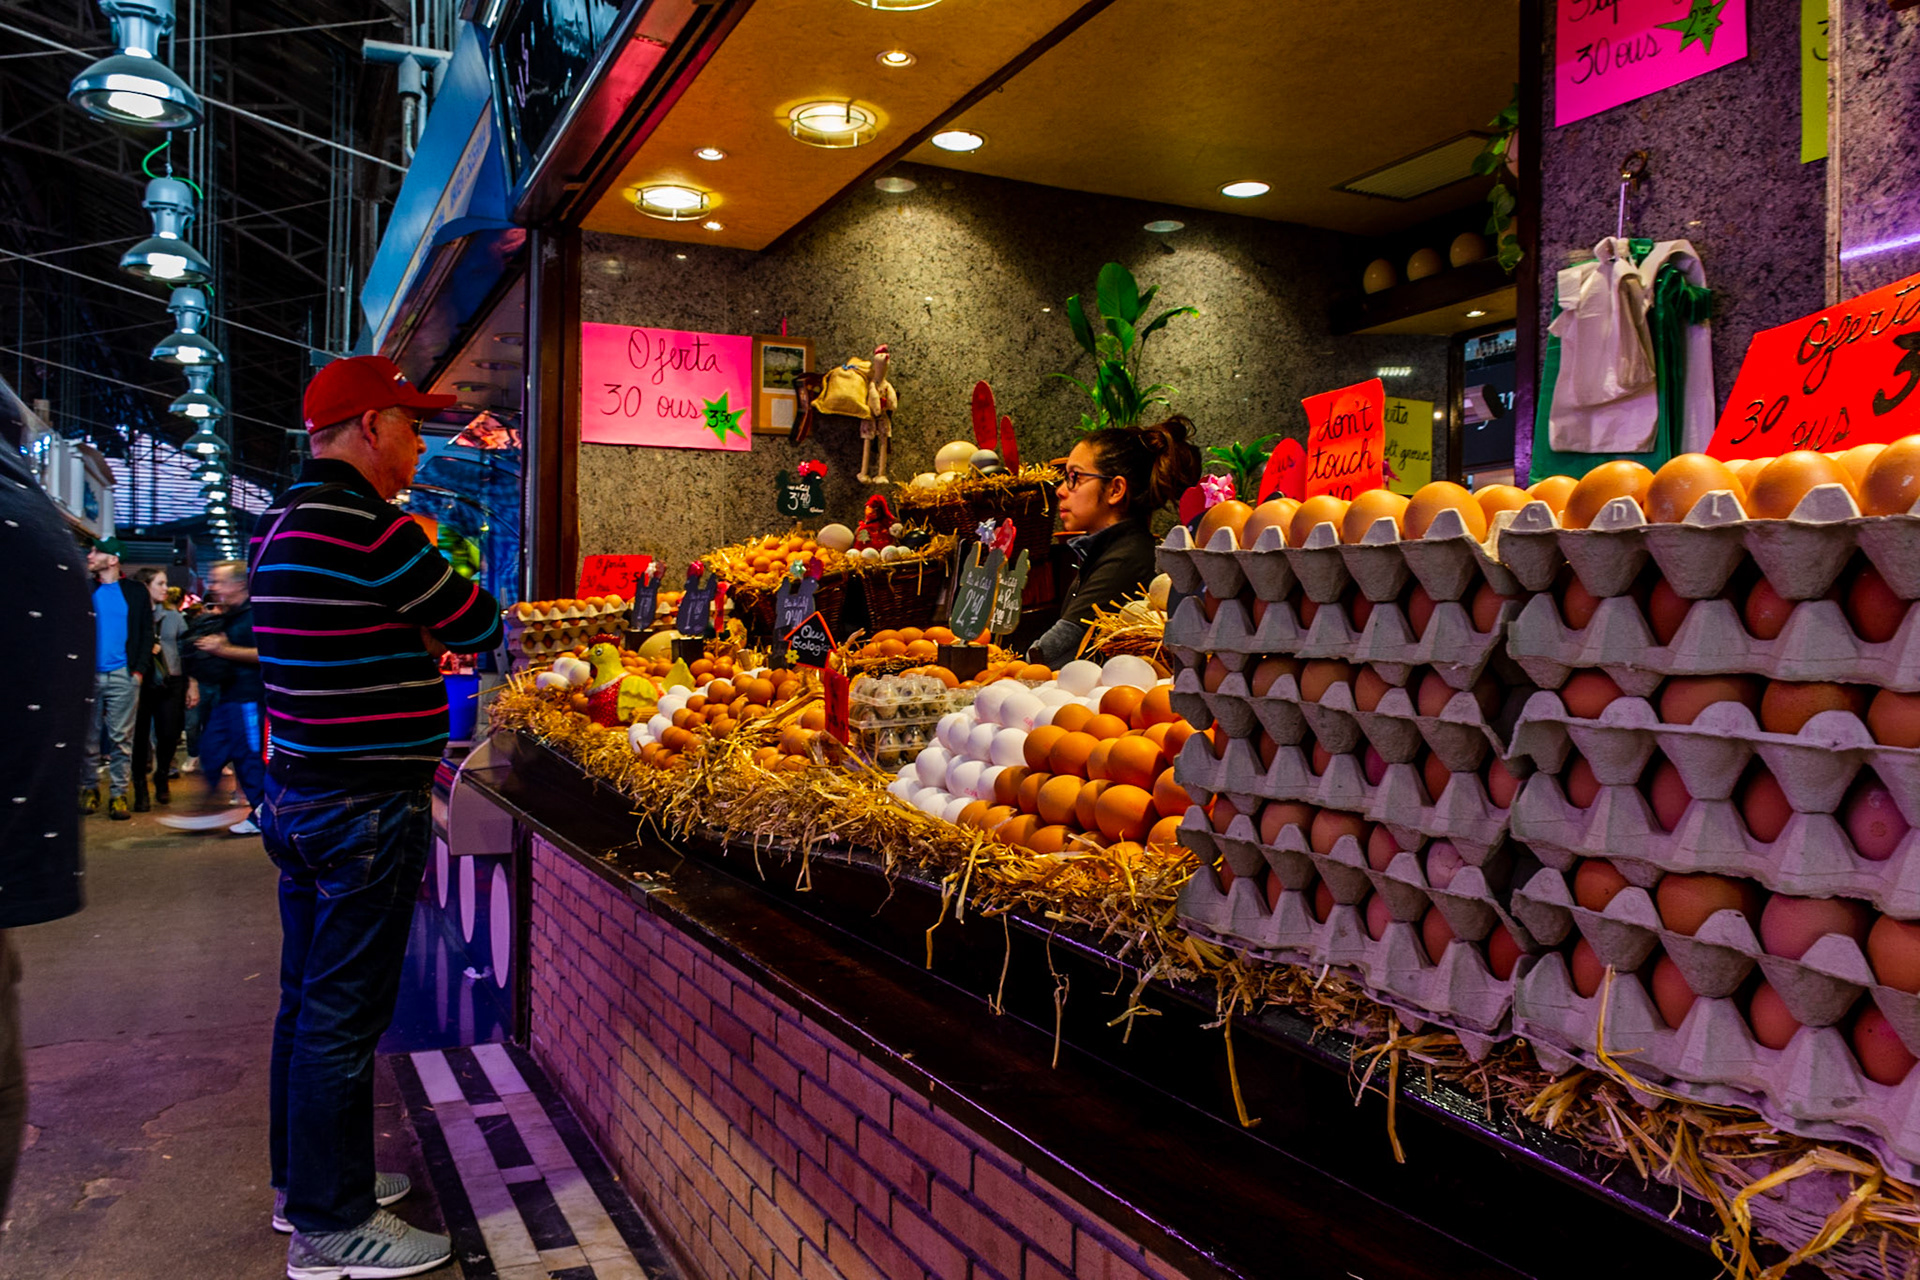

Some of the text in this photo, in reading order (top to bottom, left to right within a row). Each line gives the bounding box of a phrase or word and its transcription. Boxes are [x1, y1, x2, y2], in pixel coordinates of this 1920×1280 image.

[1571, 33, 1663, 85] 30 ous
[627, 328, 723, 386] Oferta
[1796, 281, 1920, 396] Oferta
[600, 383, 642, 418] 30
[656, 394, 703, 420] ous
[1317, 400, 1374, 442] don't
[1730, 394, 1790, 445] 30
[1308, 438, 1376, 482] touch
